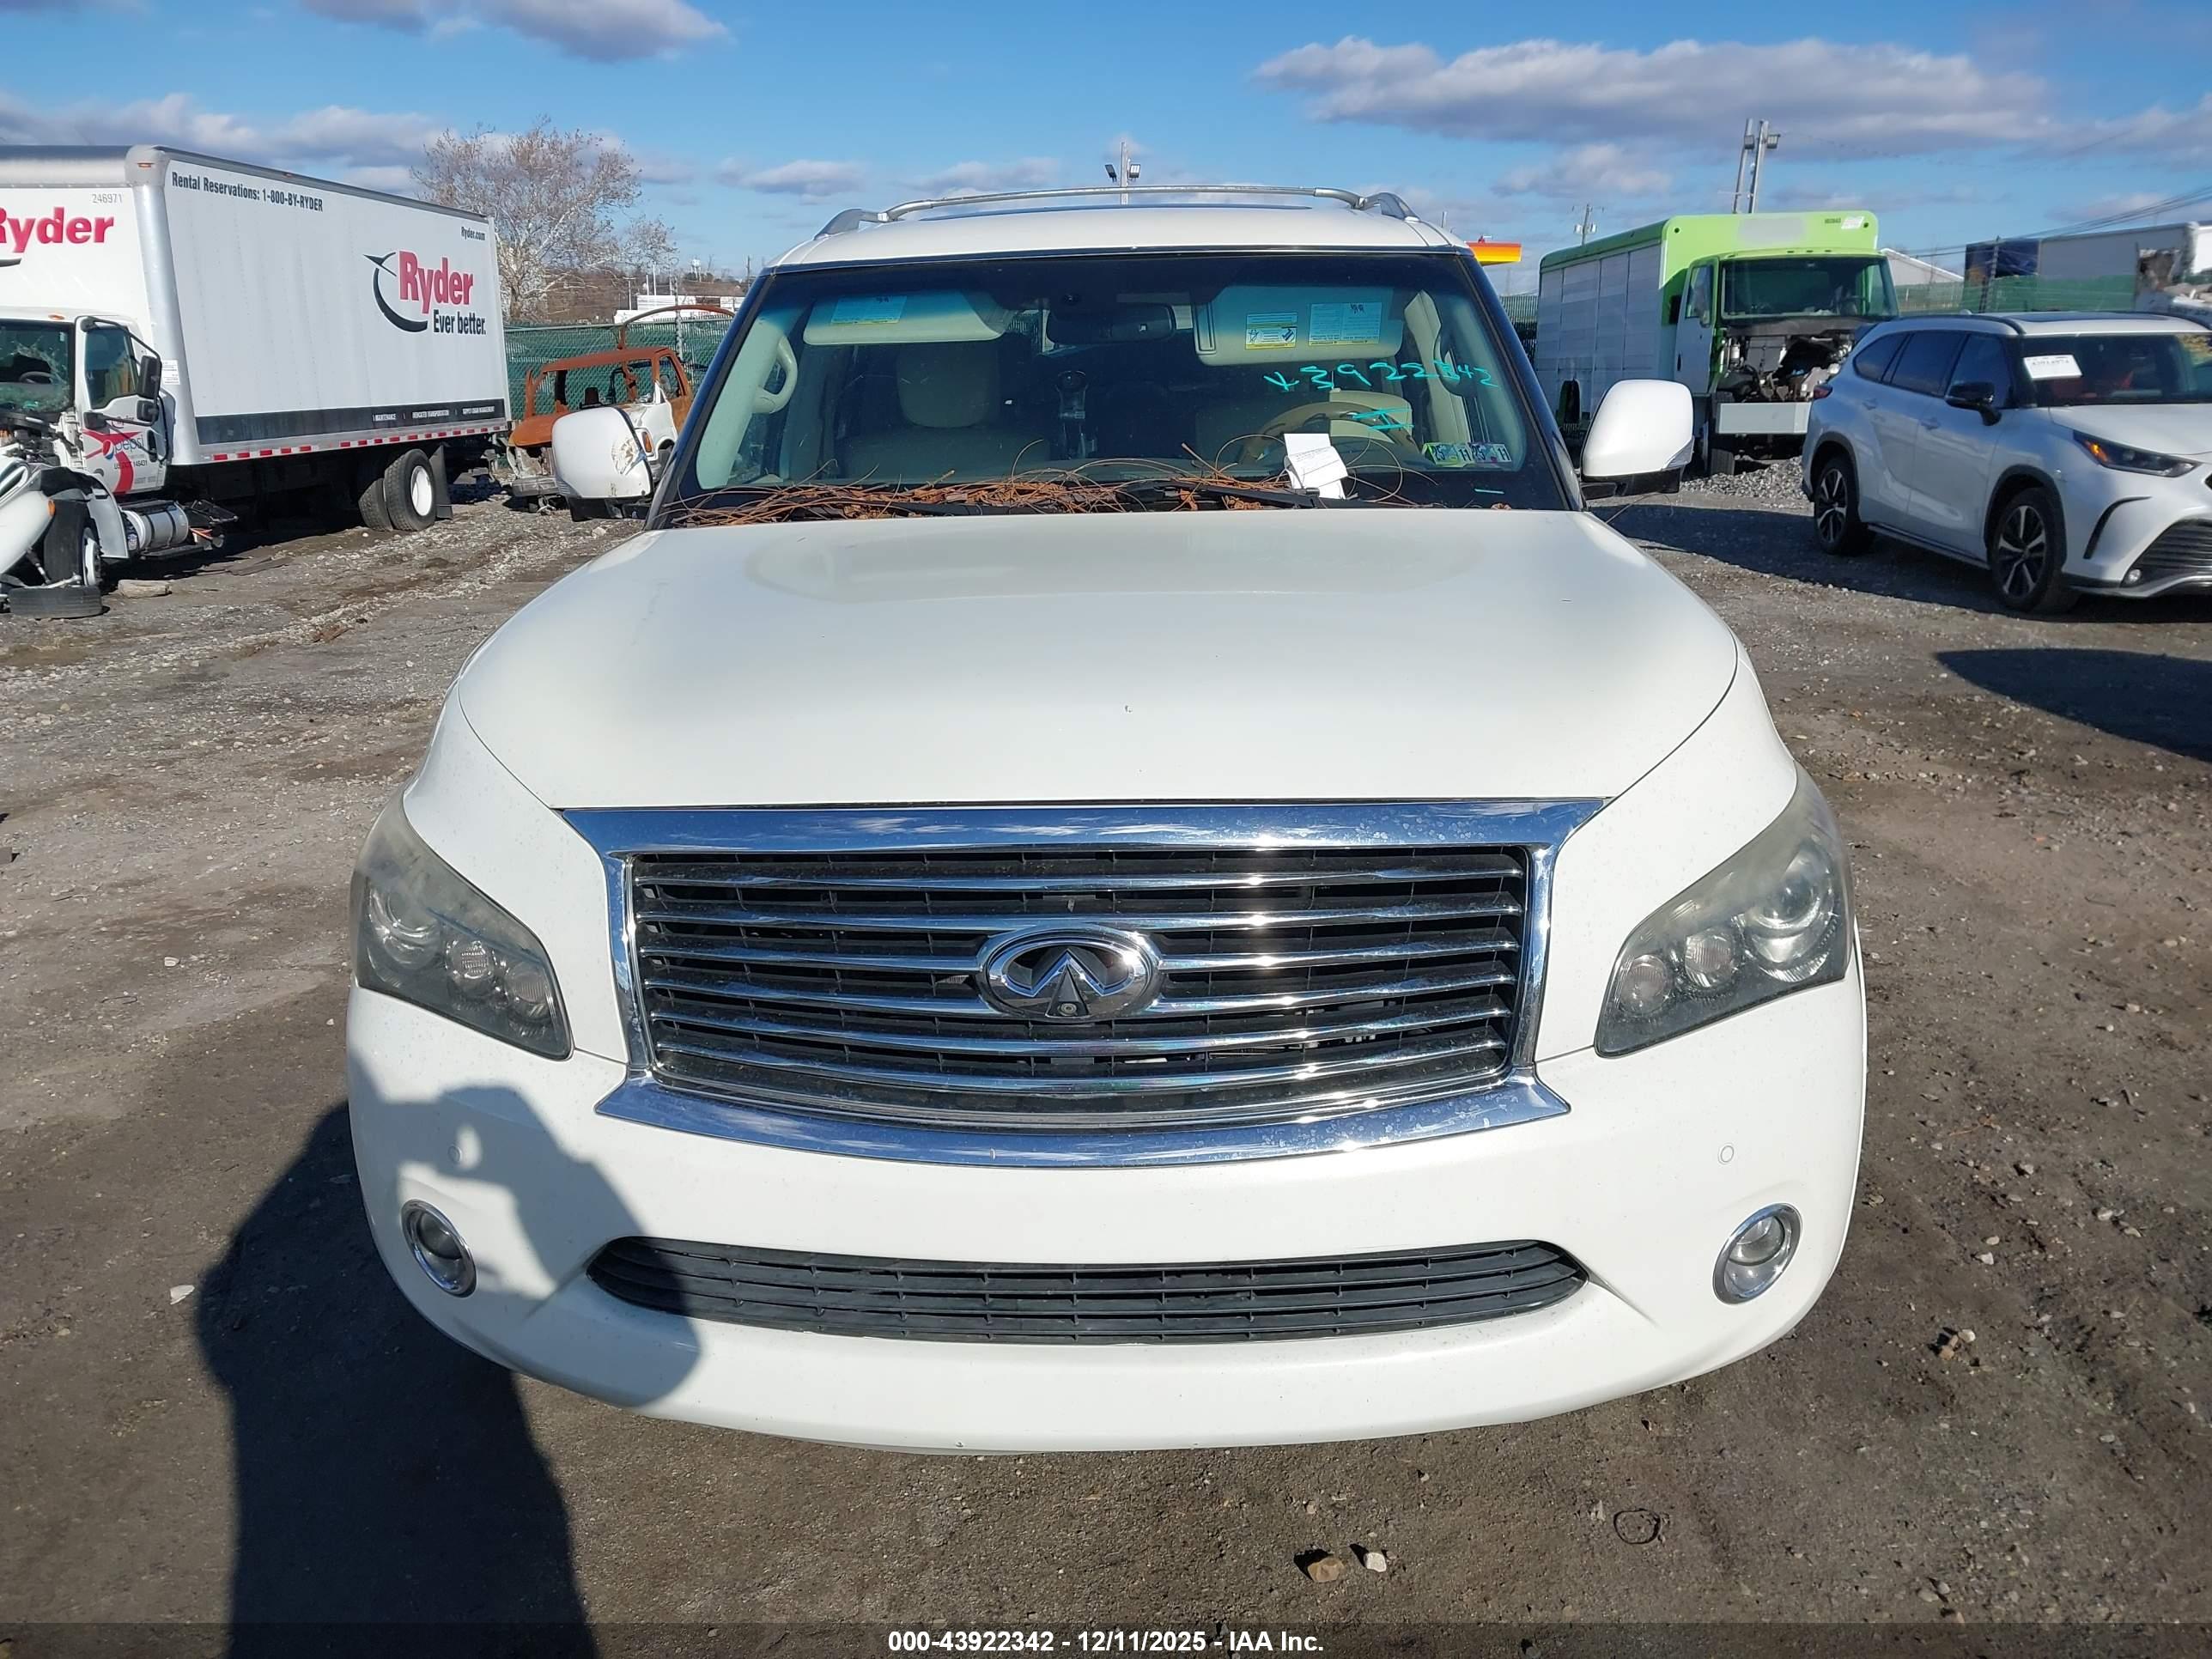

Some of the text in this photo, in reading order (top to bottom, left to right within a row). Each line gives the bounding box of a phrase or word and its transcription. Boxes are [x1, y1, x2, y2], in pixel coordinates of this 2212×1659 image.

[92, 193, 124, 204] 246971
[172, 172, 324, 212] Rental Reservations: 1-800-BY-RYDER
[0, 206, 114, 253] yder
[461, 226, 486, 241] Ryder.com
[399, 251, 474, 314] Ryder
[433, 309, 487, 335] Ever better.
